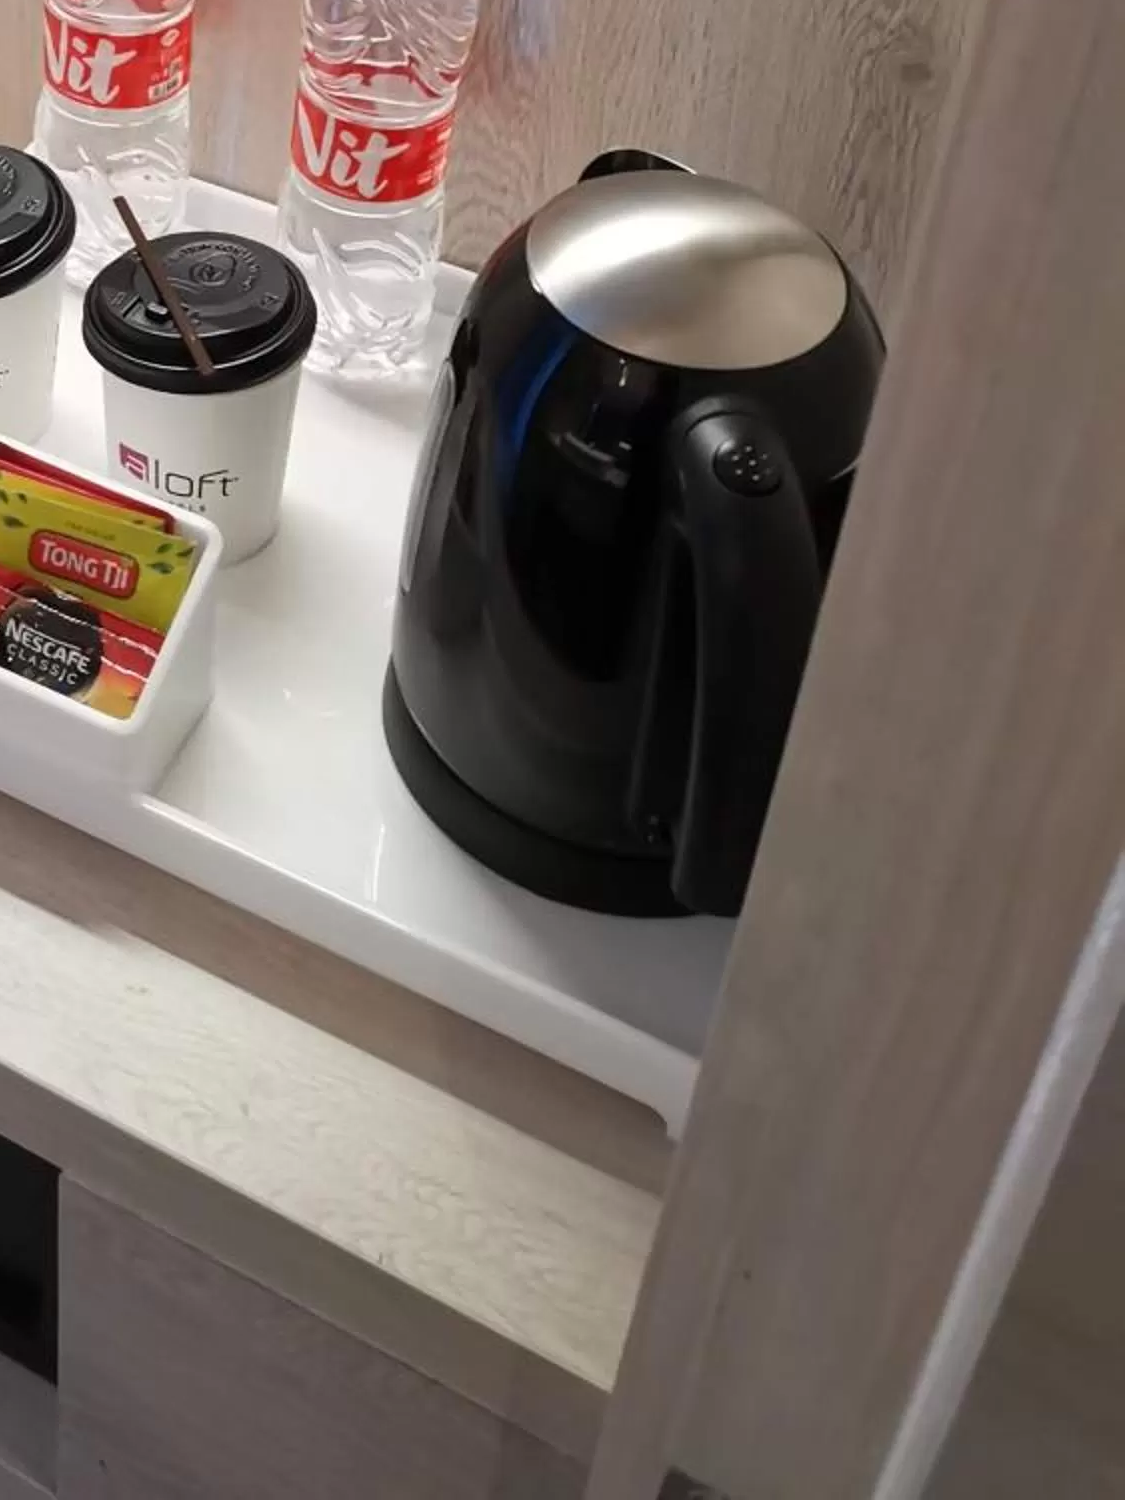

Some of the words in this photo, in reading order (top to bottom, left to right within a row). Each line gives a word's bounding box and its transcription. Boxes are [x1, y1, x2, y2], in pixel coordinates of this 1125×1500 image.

[43, 5, 137, 104] Vit
[298, 98, 411, 198] Vit
[119, 442, 239, 498] aloft
[7, 643, 80, 686] CLASSIC
